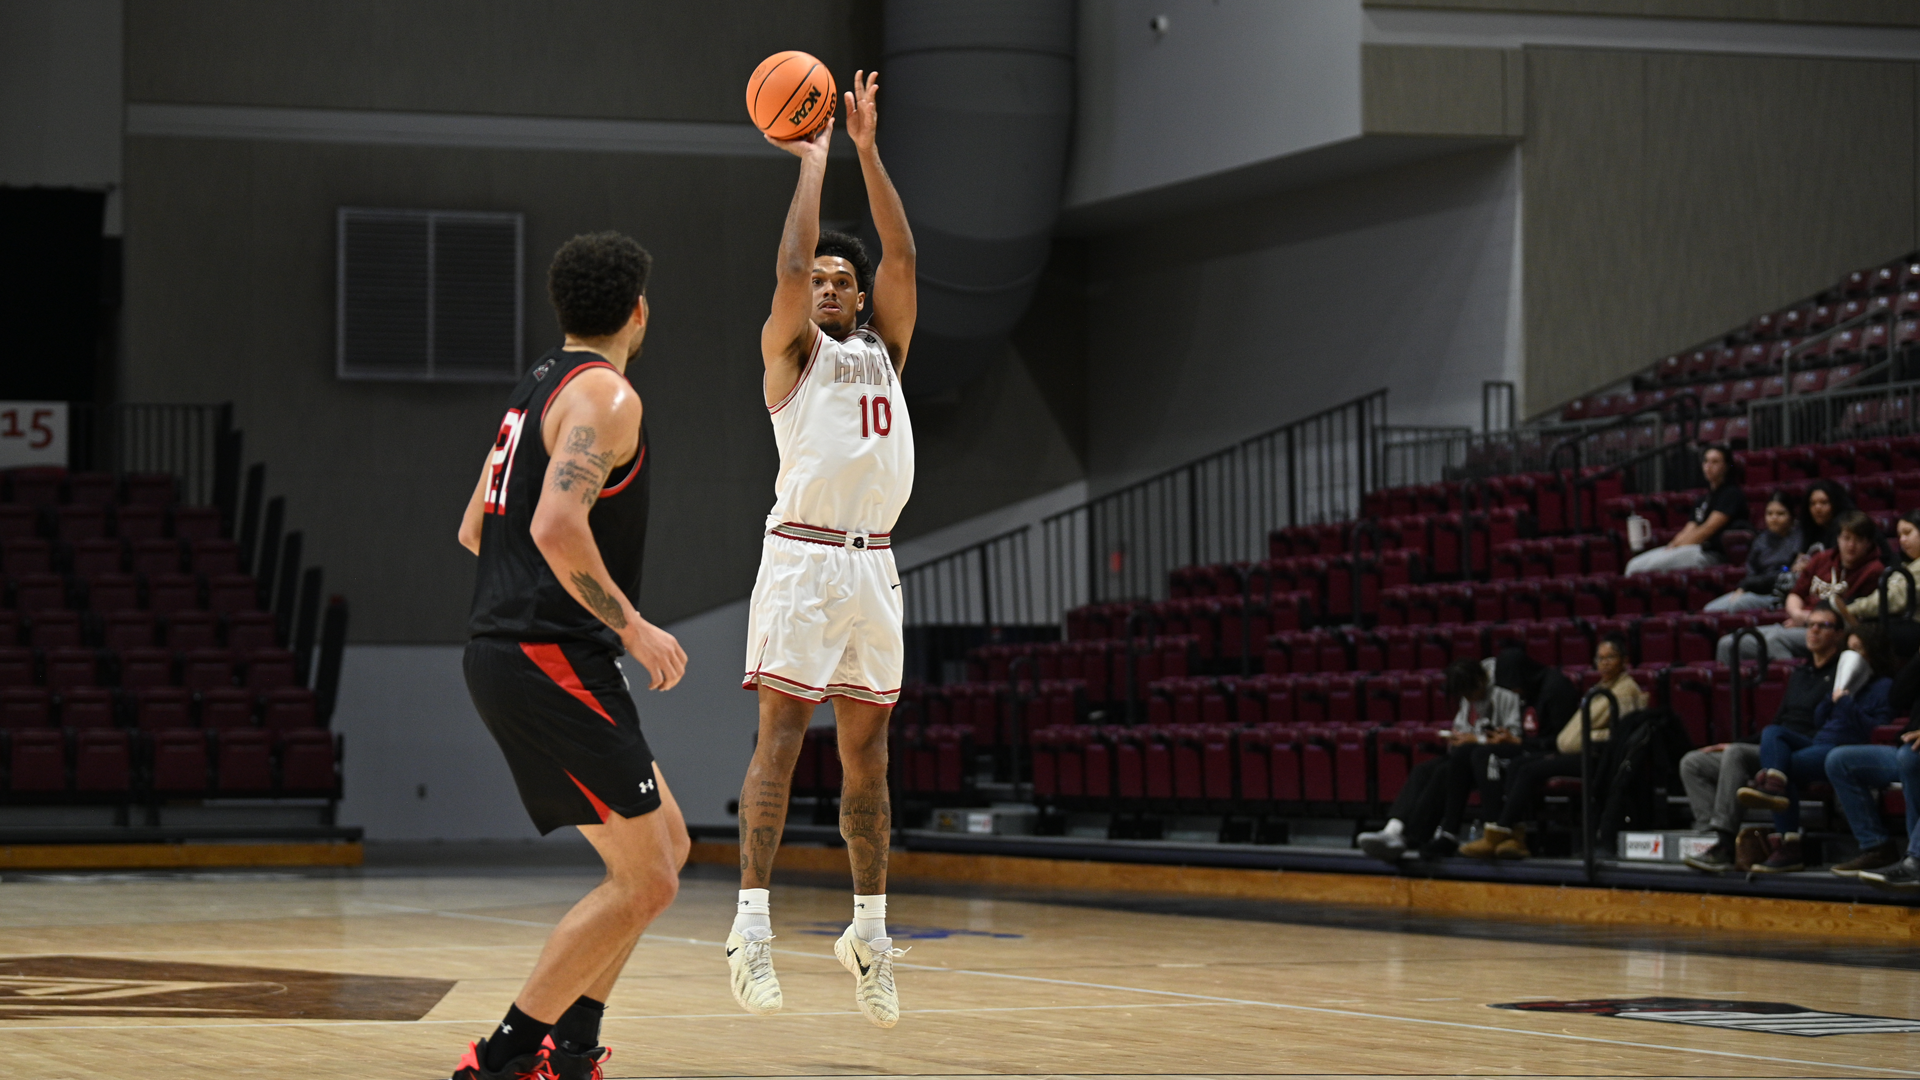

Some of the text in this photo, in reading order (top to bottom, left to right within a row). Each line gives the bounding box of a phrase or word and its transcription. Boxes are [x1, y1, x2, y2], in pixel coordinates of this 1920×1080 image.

[789, 86, 822, 126] NCAA
[834, 350, 894, 386] HAW
[2, 409, 54, 449] 15
[858, 393, 892, 438] 10
[484, 407, 528, 516] 21
